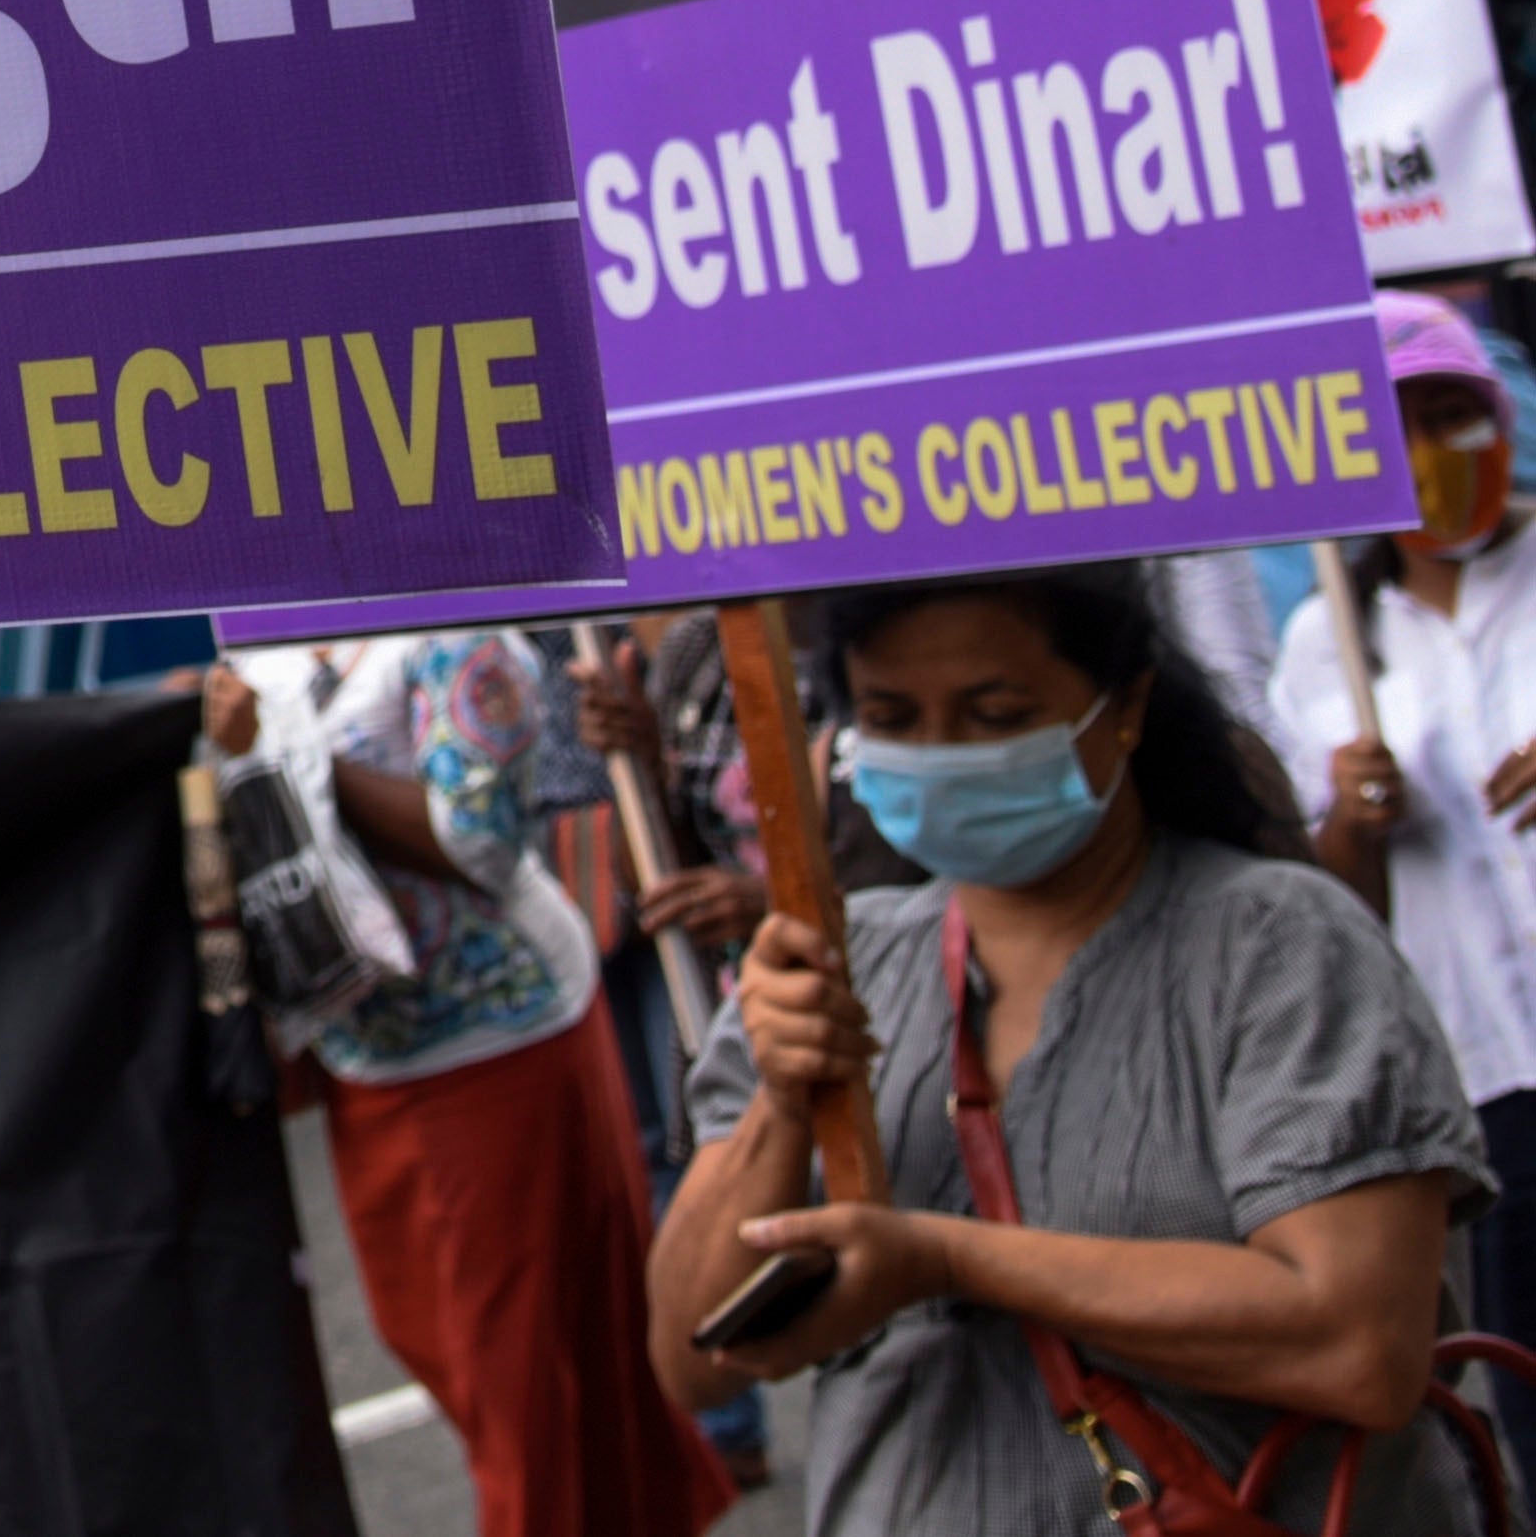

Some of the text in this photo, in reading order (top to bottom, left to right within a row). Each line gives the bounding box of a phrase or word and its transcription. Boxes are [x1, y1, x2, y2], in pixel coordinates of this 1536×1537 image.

[585, 56, 861, 320] sent
[617, 370, 1381, 560] WOMEN'S COLLECTIVE
